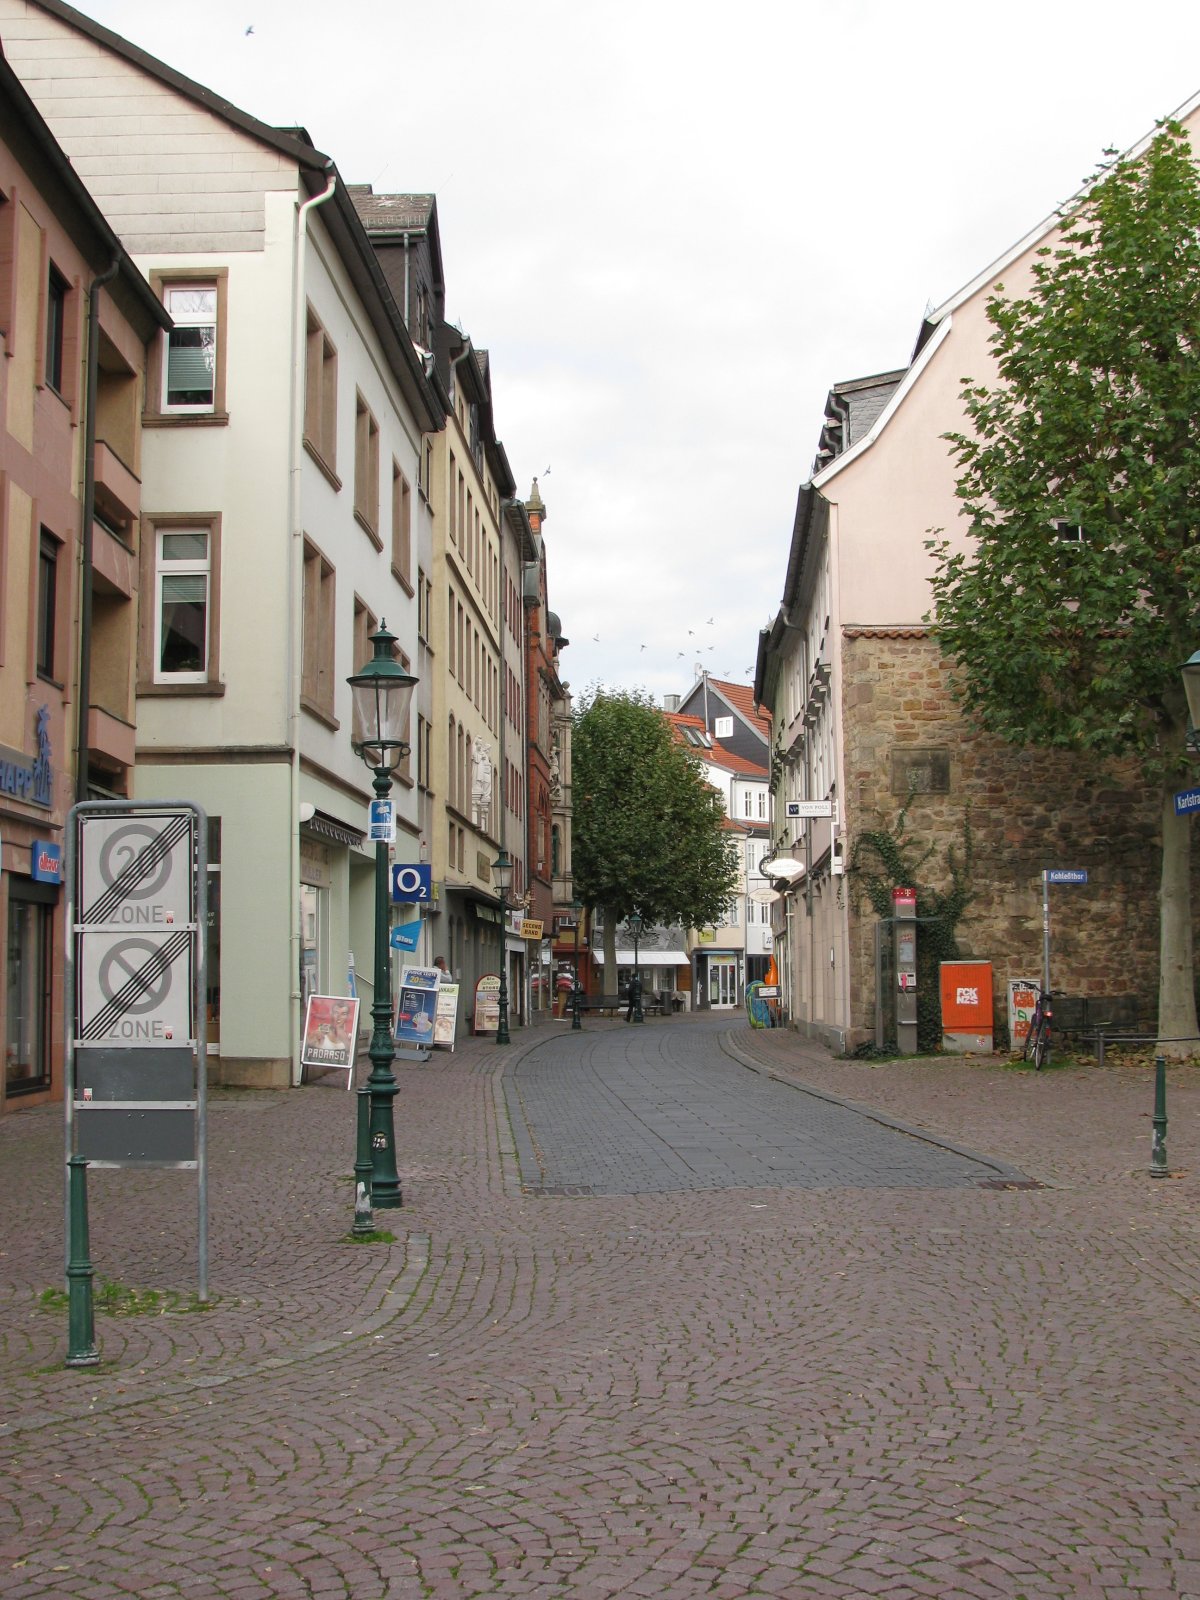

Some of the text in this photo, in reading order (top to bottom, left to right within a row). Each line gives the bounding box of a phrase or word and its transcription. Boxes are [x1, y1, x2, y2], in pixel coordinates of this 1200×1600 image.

[109, 906, 163, 923] ZONE
[522, 922, 542, 930] SECOND
[956, 988, 978, 998] FCK
[956, 996, 978, 1005] NZS
[109, 1020, 163, 1038] ZONE
